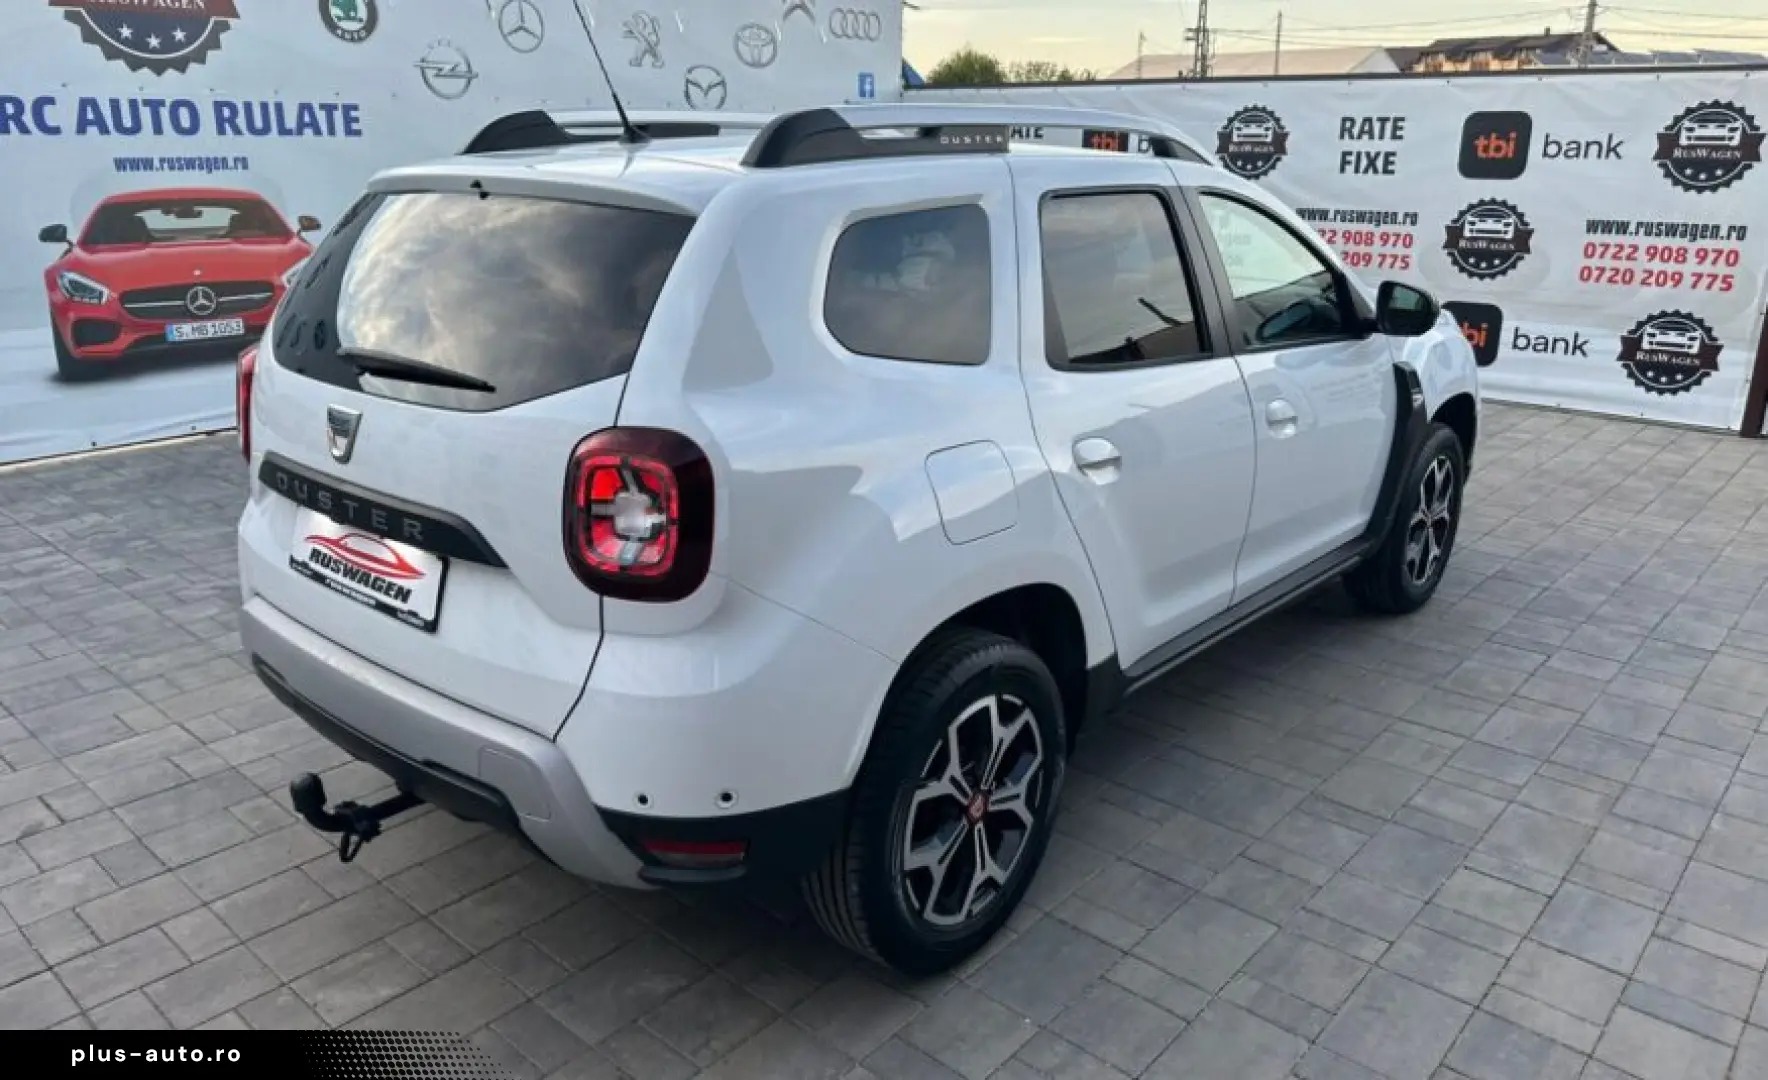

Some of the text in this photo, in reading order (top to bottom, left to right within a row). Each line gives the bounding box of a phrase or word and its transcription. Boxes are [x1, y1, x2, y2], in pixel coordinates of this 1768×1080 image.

[75, 97, 200, 137] AUTO
[213, 100, 363, 138] RULATE
[1339, 116, 1406, 140] RATE
[940, 133, 1003, 145] DUSTER
[1474, 131, 1624, 160] tbi bank
[113, 156, 249, 175] www.ruswagen.ro
[1339, 151, 1397, 174] FIXE
[1342, 230, 1375, 247] 908
[1380, 232, 1414, 249] 970
[1586, 219, 1748, 242] www.ruswagen.ro
[1378, 254, 1412, 270] 775
[1583, 242, 1740, 268] 0722 908 970
[1579, 266, 1735, 292] 0720 209 775
[1461, 322, 1591, 358] bi bank
[275, 471, 424, 542] DUSTER
[308, 548, 413, 604] RUSWAGEN
